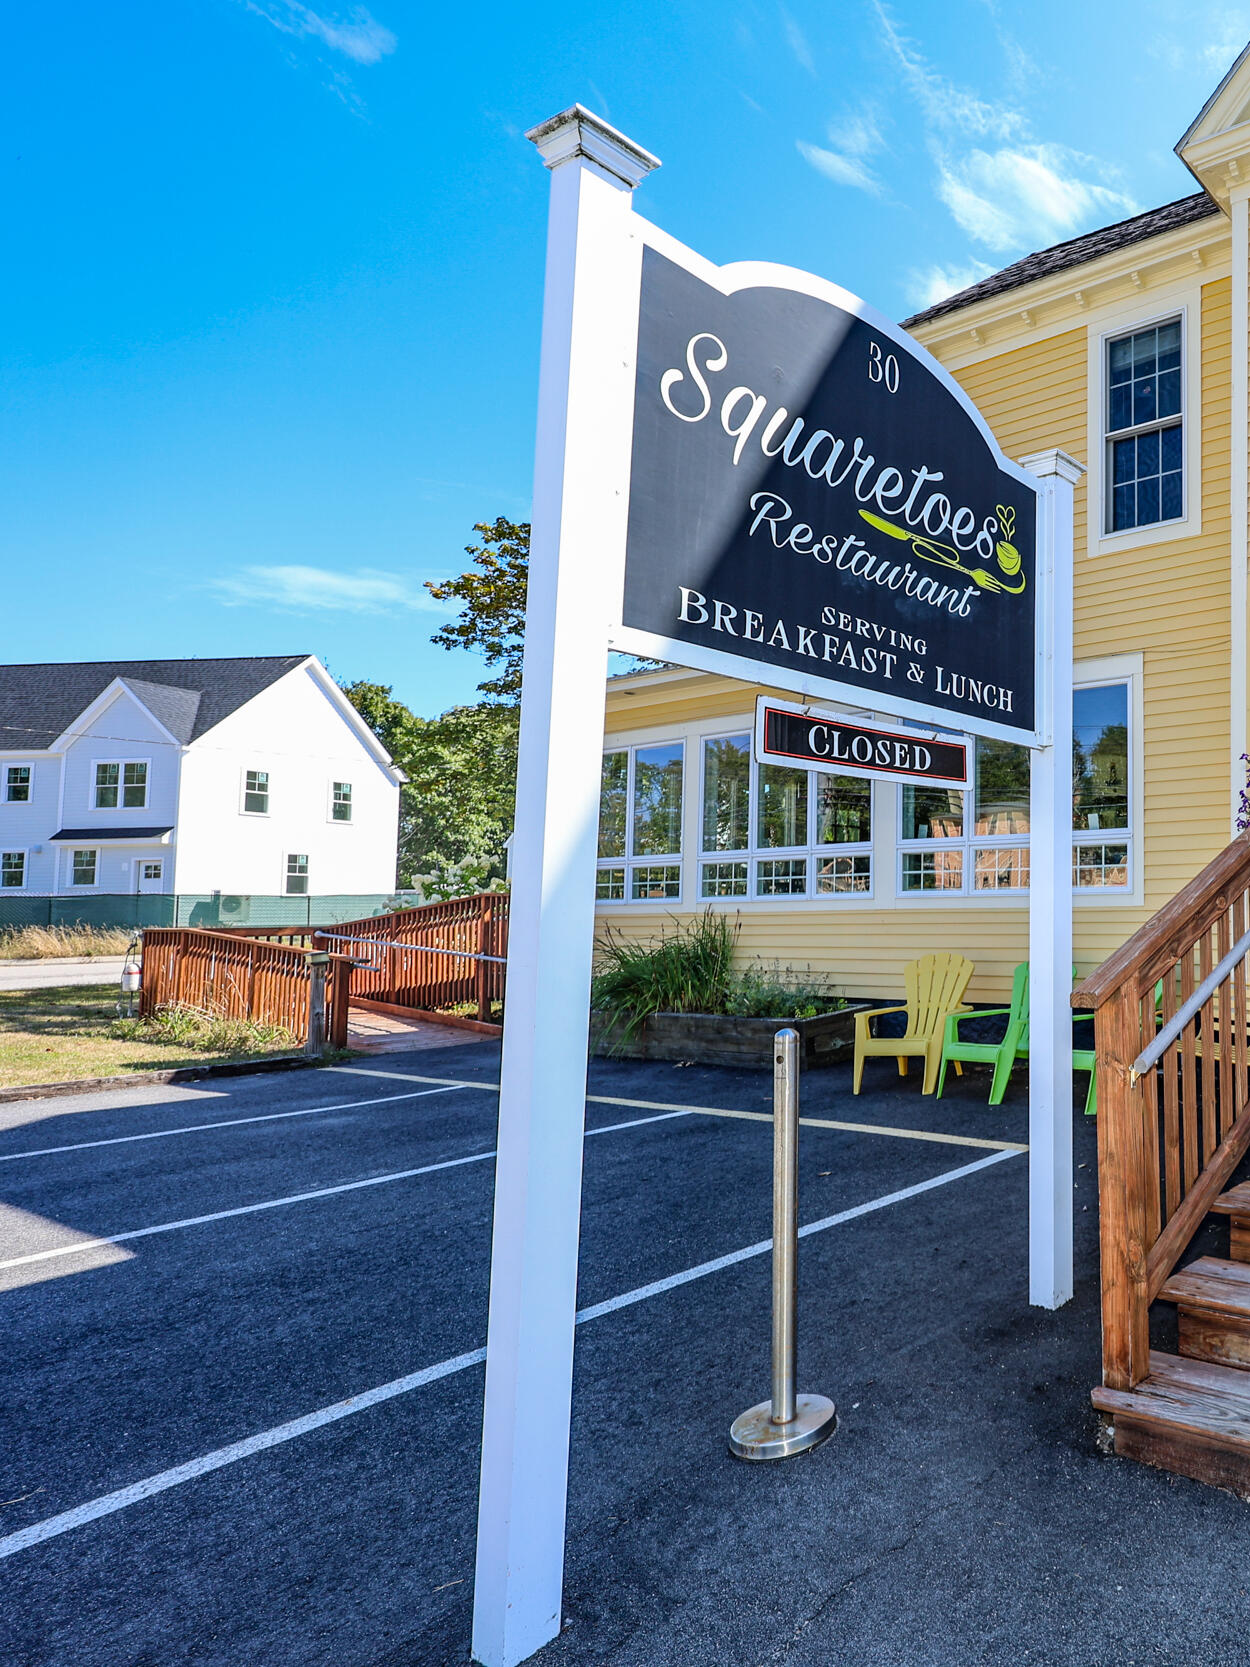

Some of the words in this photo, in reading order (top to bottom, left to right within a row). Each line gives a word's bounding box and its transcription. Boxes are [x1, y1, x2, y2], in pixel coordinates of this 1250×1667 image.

[868, 340, 900, 394] 30
[660, 332, 998, 560] Squaretoes
[748, 491, 981, 617] Restaurant
[677, 586, 897, 679] BREAKFAST
[907, 662, 925, 684] &
[934, 666, 1014, 713] LUNCH
[821, 606, 927, 656] SERVING
[807, 724, 932, 771] CLOSED
